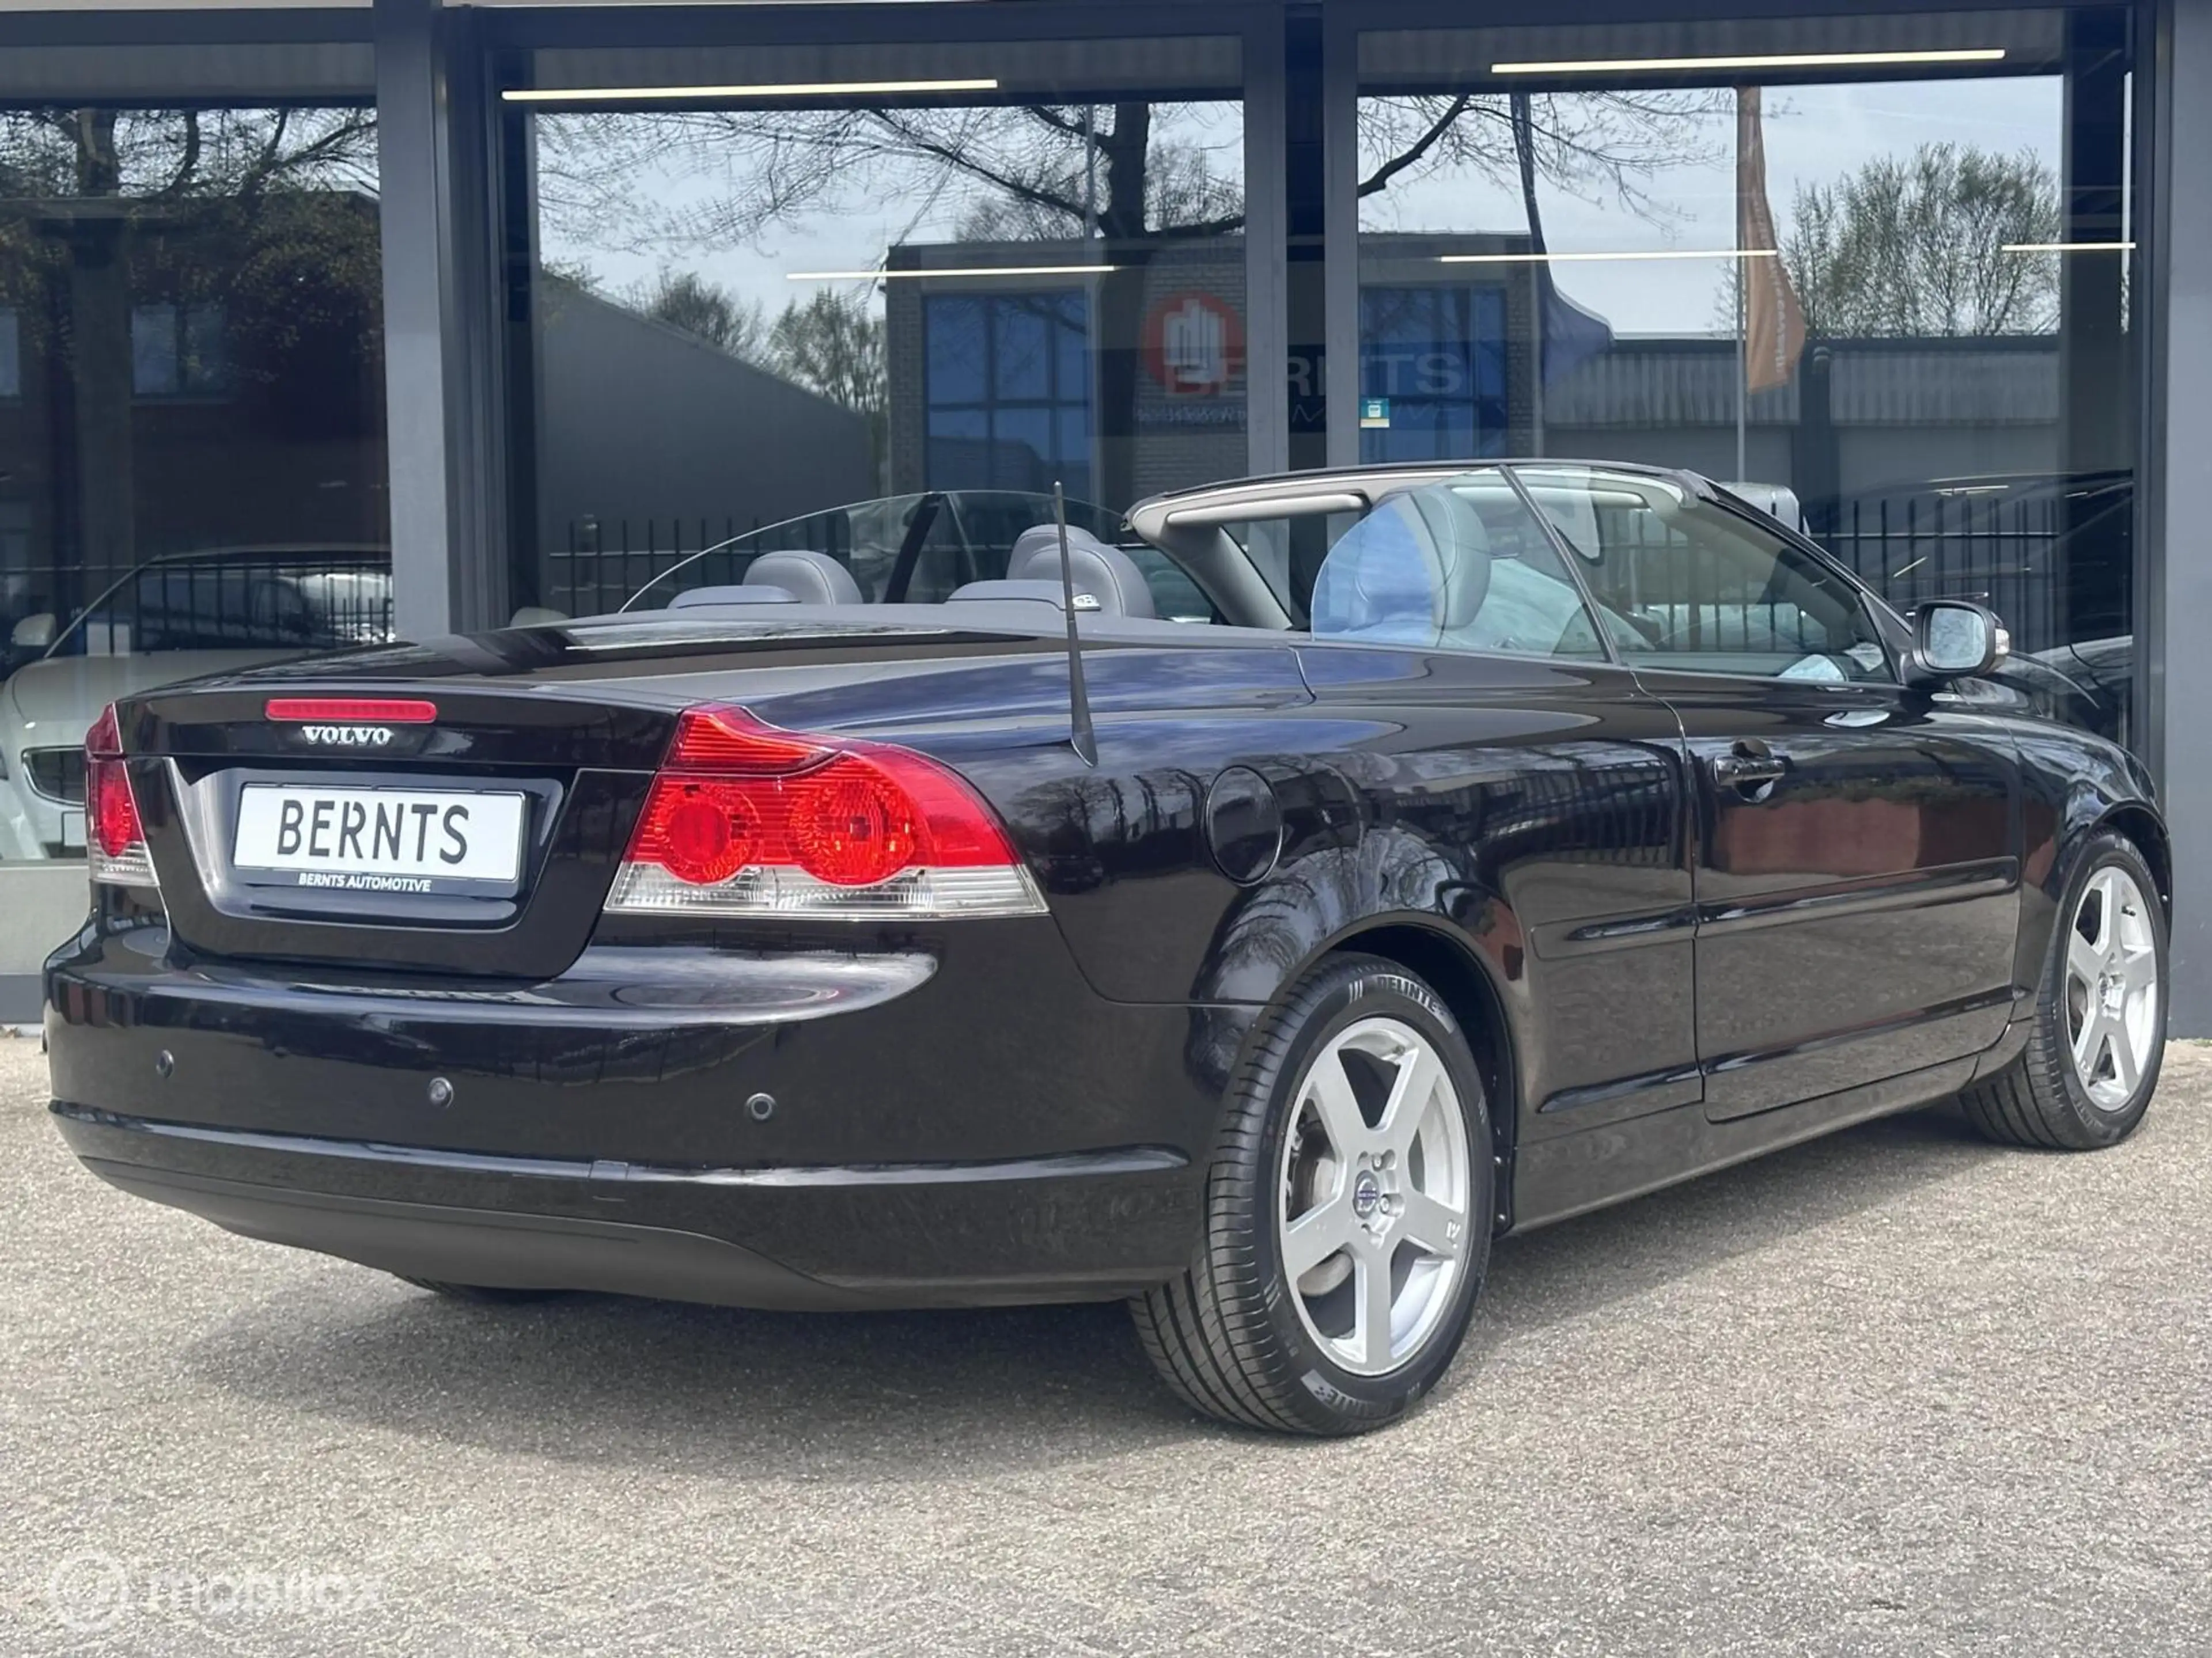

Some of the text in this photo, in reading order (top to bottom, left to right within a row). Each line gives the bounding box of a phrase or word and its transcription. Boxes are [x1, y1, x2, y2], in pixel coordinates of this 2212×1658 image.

[302, 726, 394, 746] VOLVO
[277, 799, 470, 864] BERNTS
[298, 872, 431, 892] BERNTS AUTOMOTIVE
